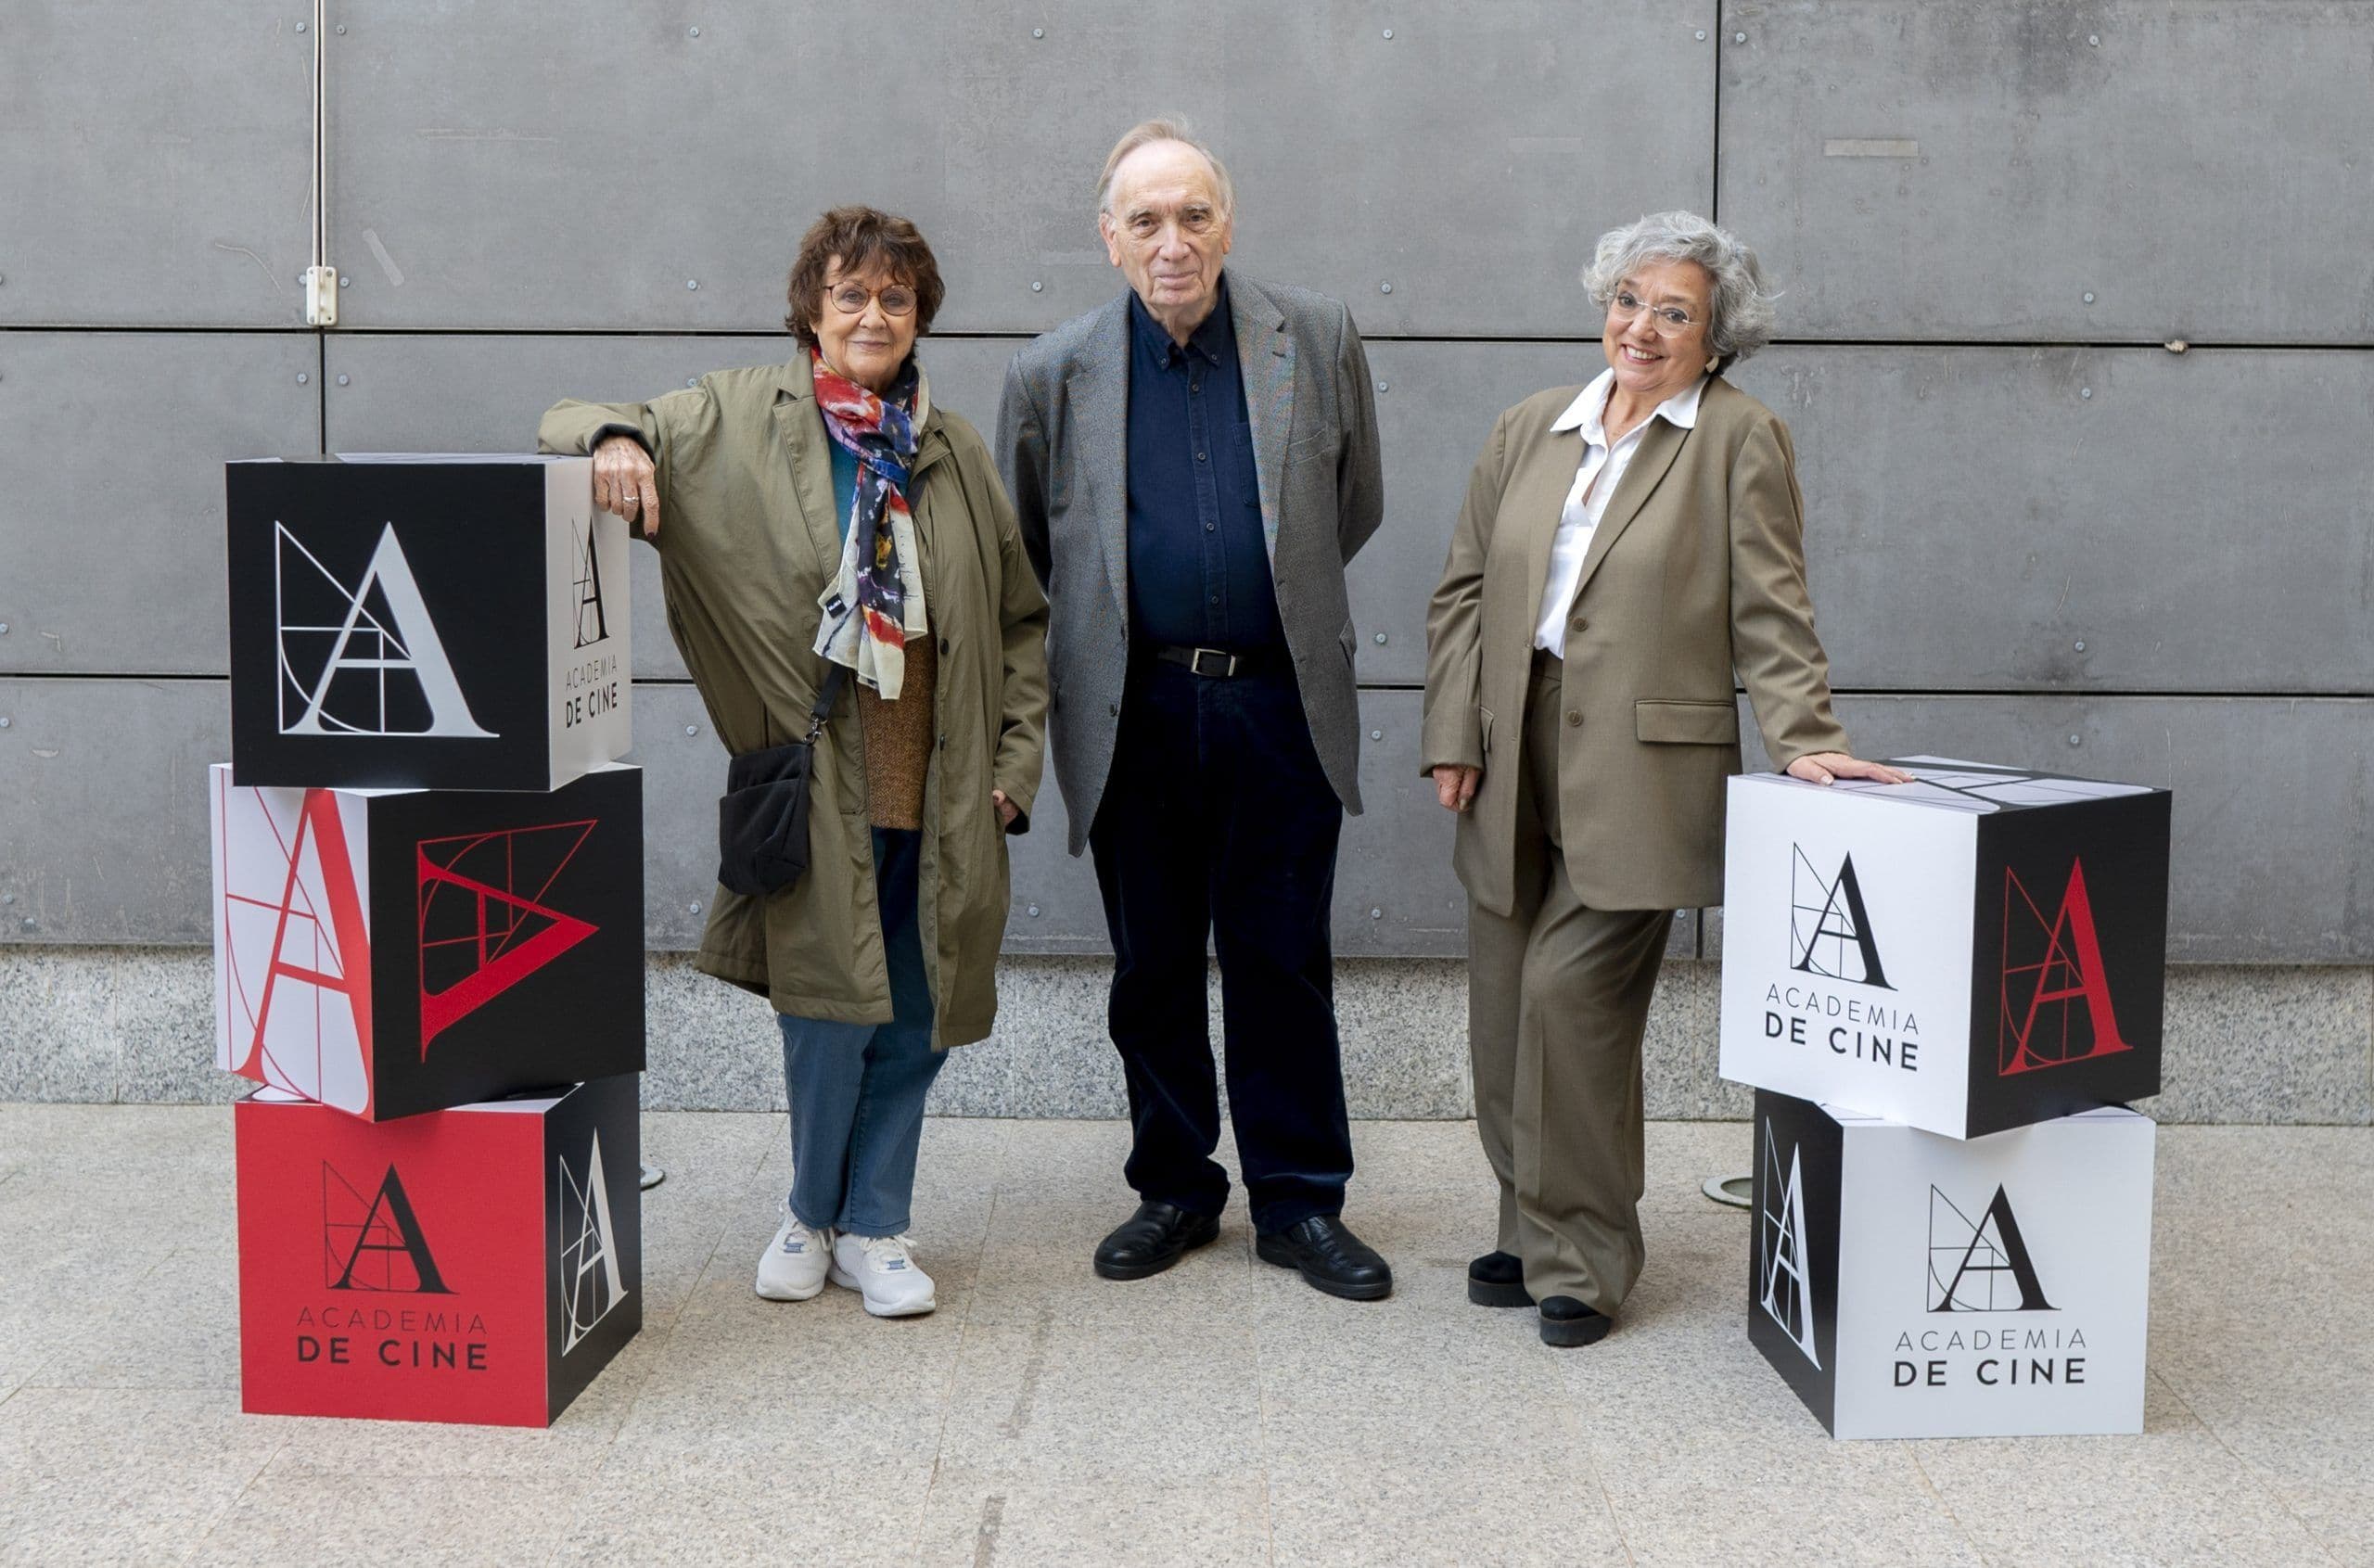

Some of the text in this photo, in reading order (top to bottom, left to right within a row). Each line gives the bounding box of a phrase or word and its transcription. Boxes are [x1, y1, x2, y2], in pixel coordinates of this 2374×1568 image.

[566, 655, 617, 691] ACADEMIA
[566, 682, 618, 729] DE CINE
[1766, 983, 1920, 1036] ACADEMIA
[1765, 1011, 1920, 1072] DE CINE
[297, 1306, 488, 1335] ACADEMIA
[298, 1335, 488, 1370] DE CINE
[1895, 1327, 2087, 1352] ACADEMIA
[1893, 1358, 2087, 1387] DE CINE
